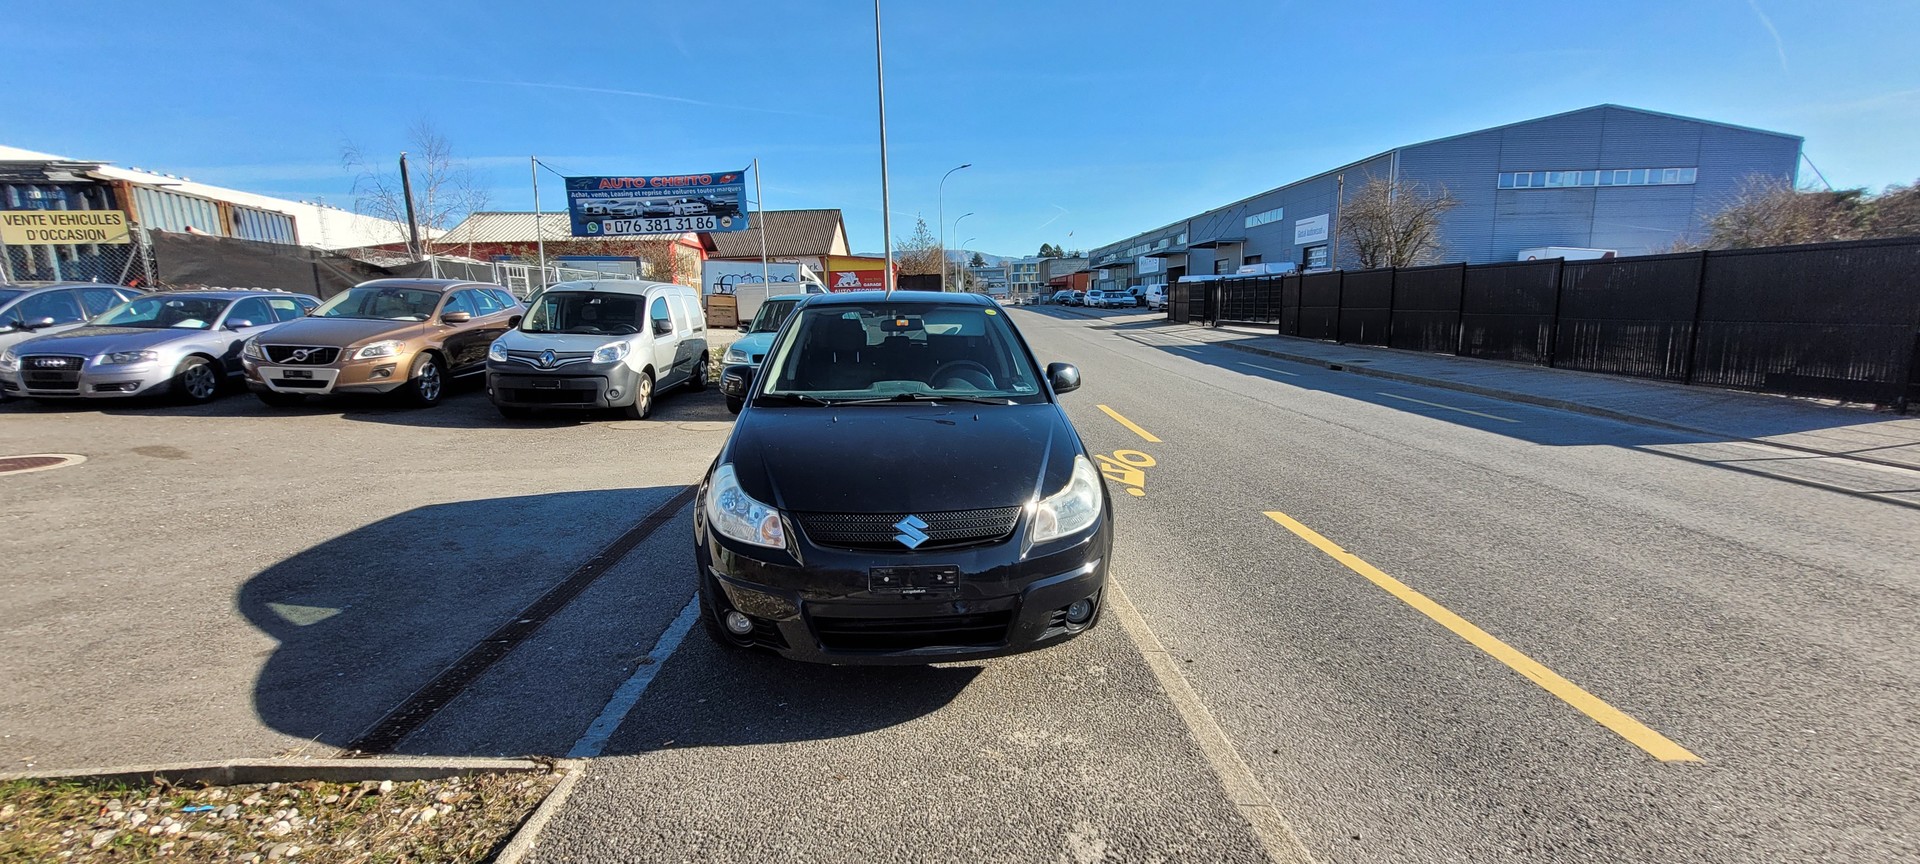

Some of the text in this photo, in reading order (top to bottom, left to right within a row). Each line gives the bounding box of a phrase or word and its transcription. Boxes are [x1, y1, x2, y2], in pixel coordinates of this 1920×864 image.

[599, 174, 713, 189] AUTO CHEITO
[611, 190, 634, 199] Leasing
[641, 188, 663, 197] reprise
[672, 187, 696, 195] voitures
[716, 186, 741, 194] marques
[3, 213, 121, 226] VENTE VEHICULES
[614, 216, 714, 233] 076 381 31 86
[26, 228, 107, 241] D'OCCASION
